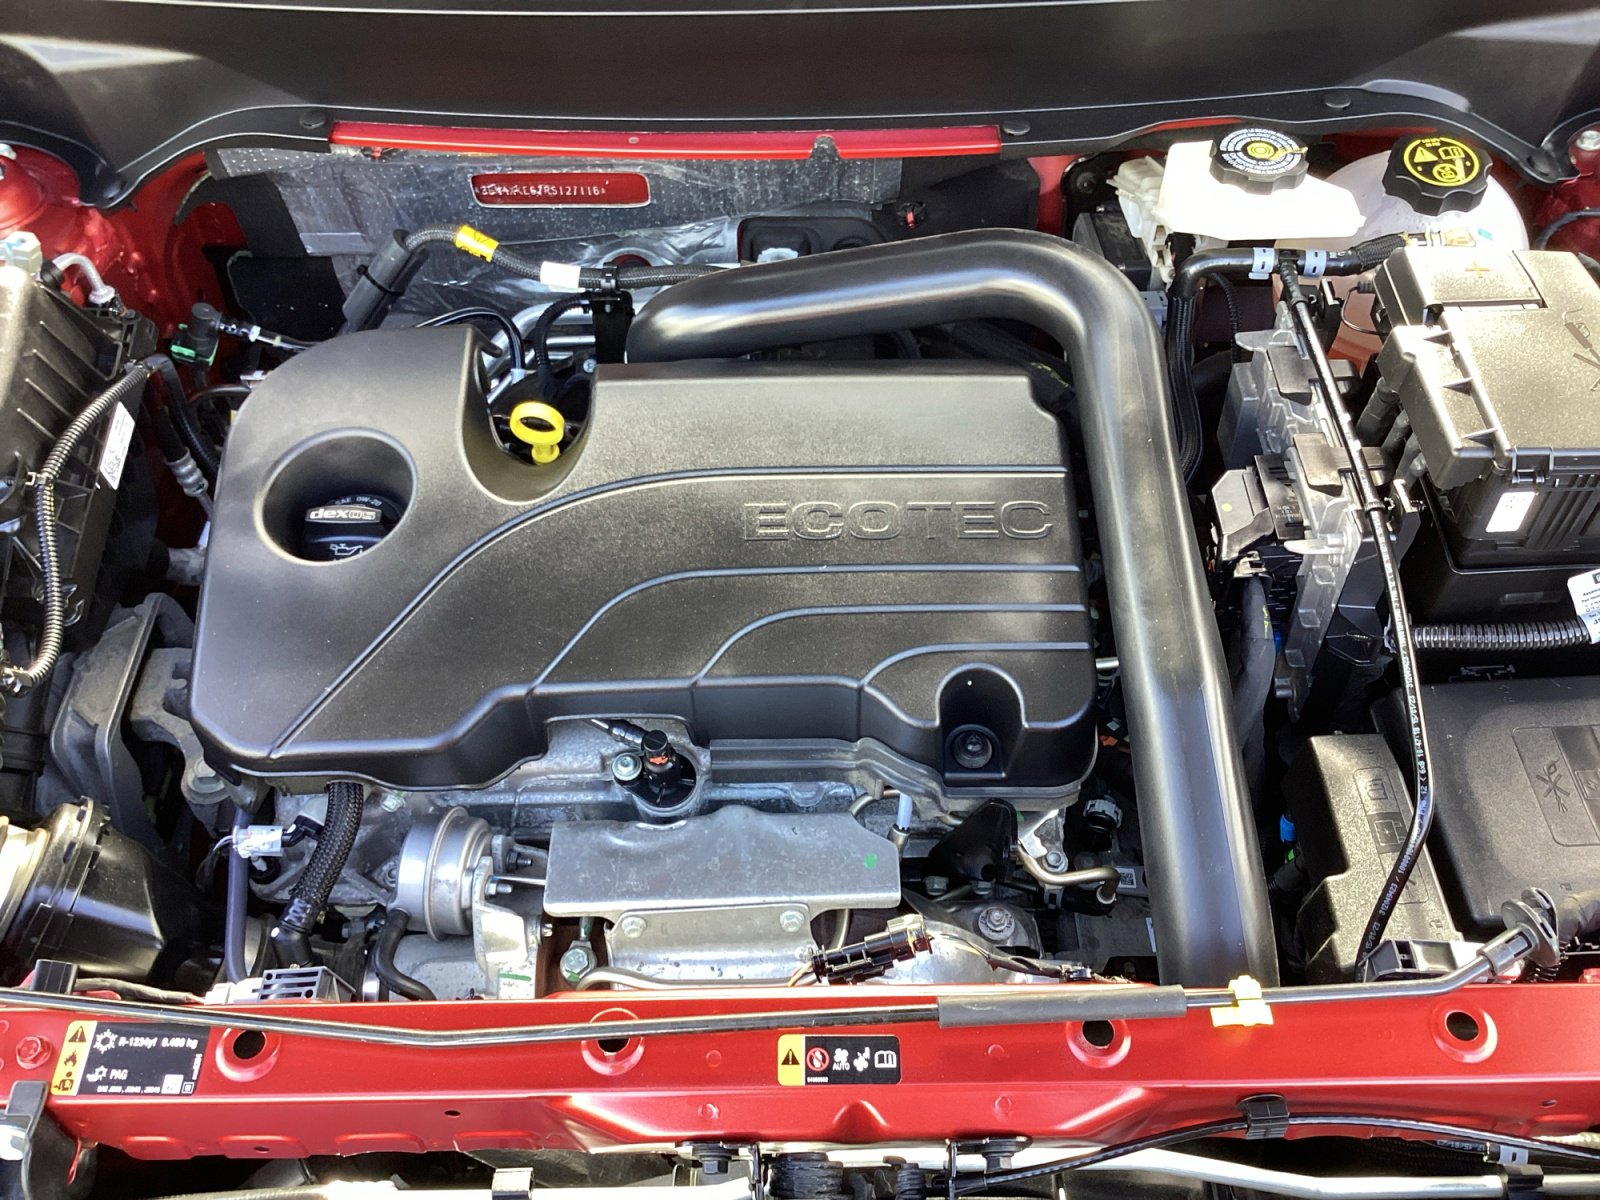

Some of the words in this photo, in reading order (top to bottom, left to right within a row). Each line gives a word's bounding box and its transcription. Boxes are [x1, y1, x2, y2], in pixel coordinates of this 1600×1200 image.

[309, 508, 377, 520] dexos
[743, 501, 1053, 539] ECOTEC
[118, 1036, 159, 1050] R-1234yf
[832, 1062, 850, 1071] AUTO
[109, 1068, 129, 1081] PAG
